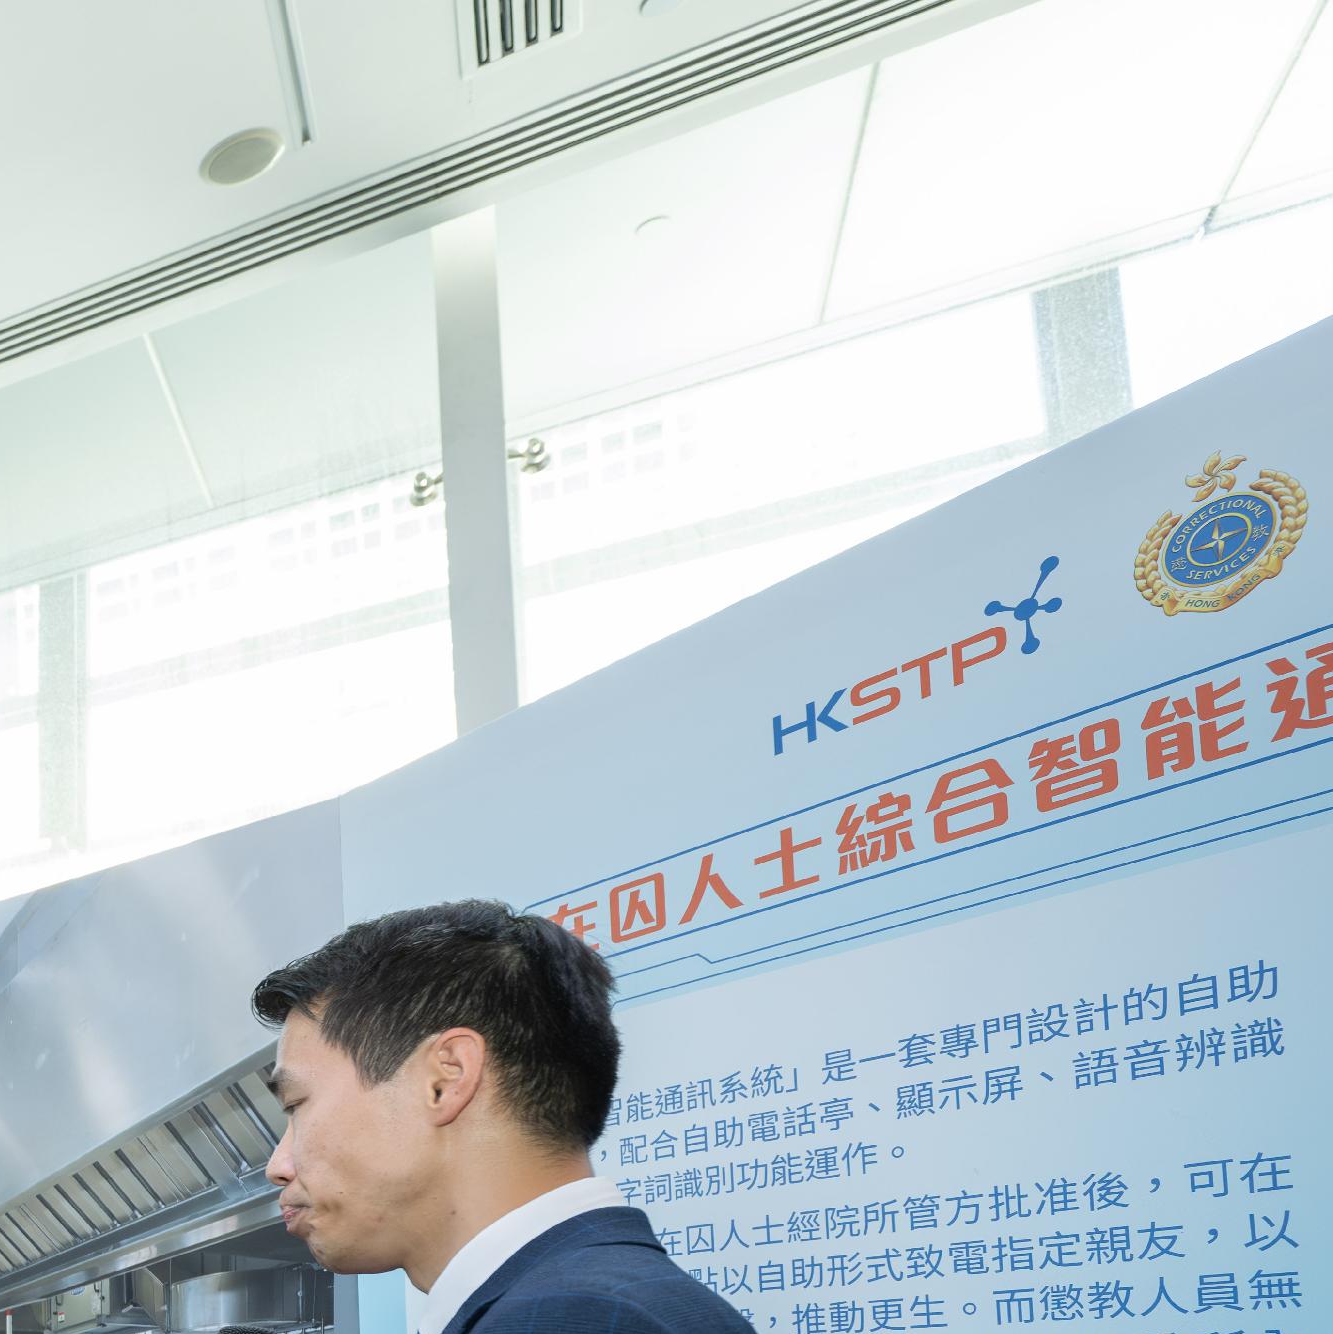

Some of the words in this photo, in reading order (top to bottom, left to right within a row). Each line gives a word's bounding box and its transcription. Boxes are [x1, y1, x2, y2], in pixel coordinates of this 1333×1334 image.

[1171, 499, 1267, 554] CORRECTIONAL
[1185, 546, 1256, 580] SERVICES
[1184, 598, 1221, 609] HONG
[1227, 574, 1261, 601] KONG
[773, 626, 1008, 756] HKSTP
